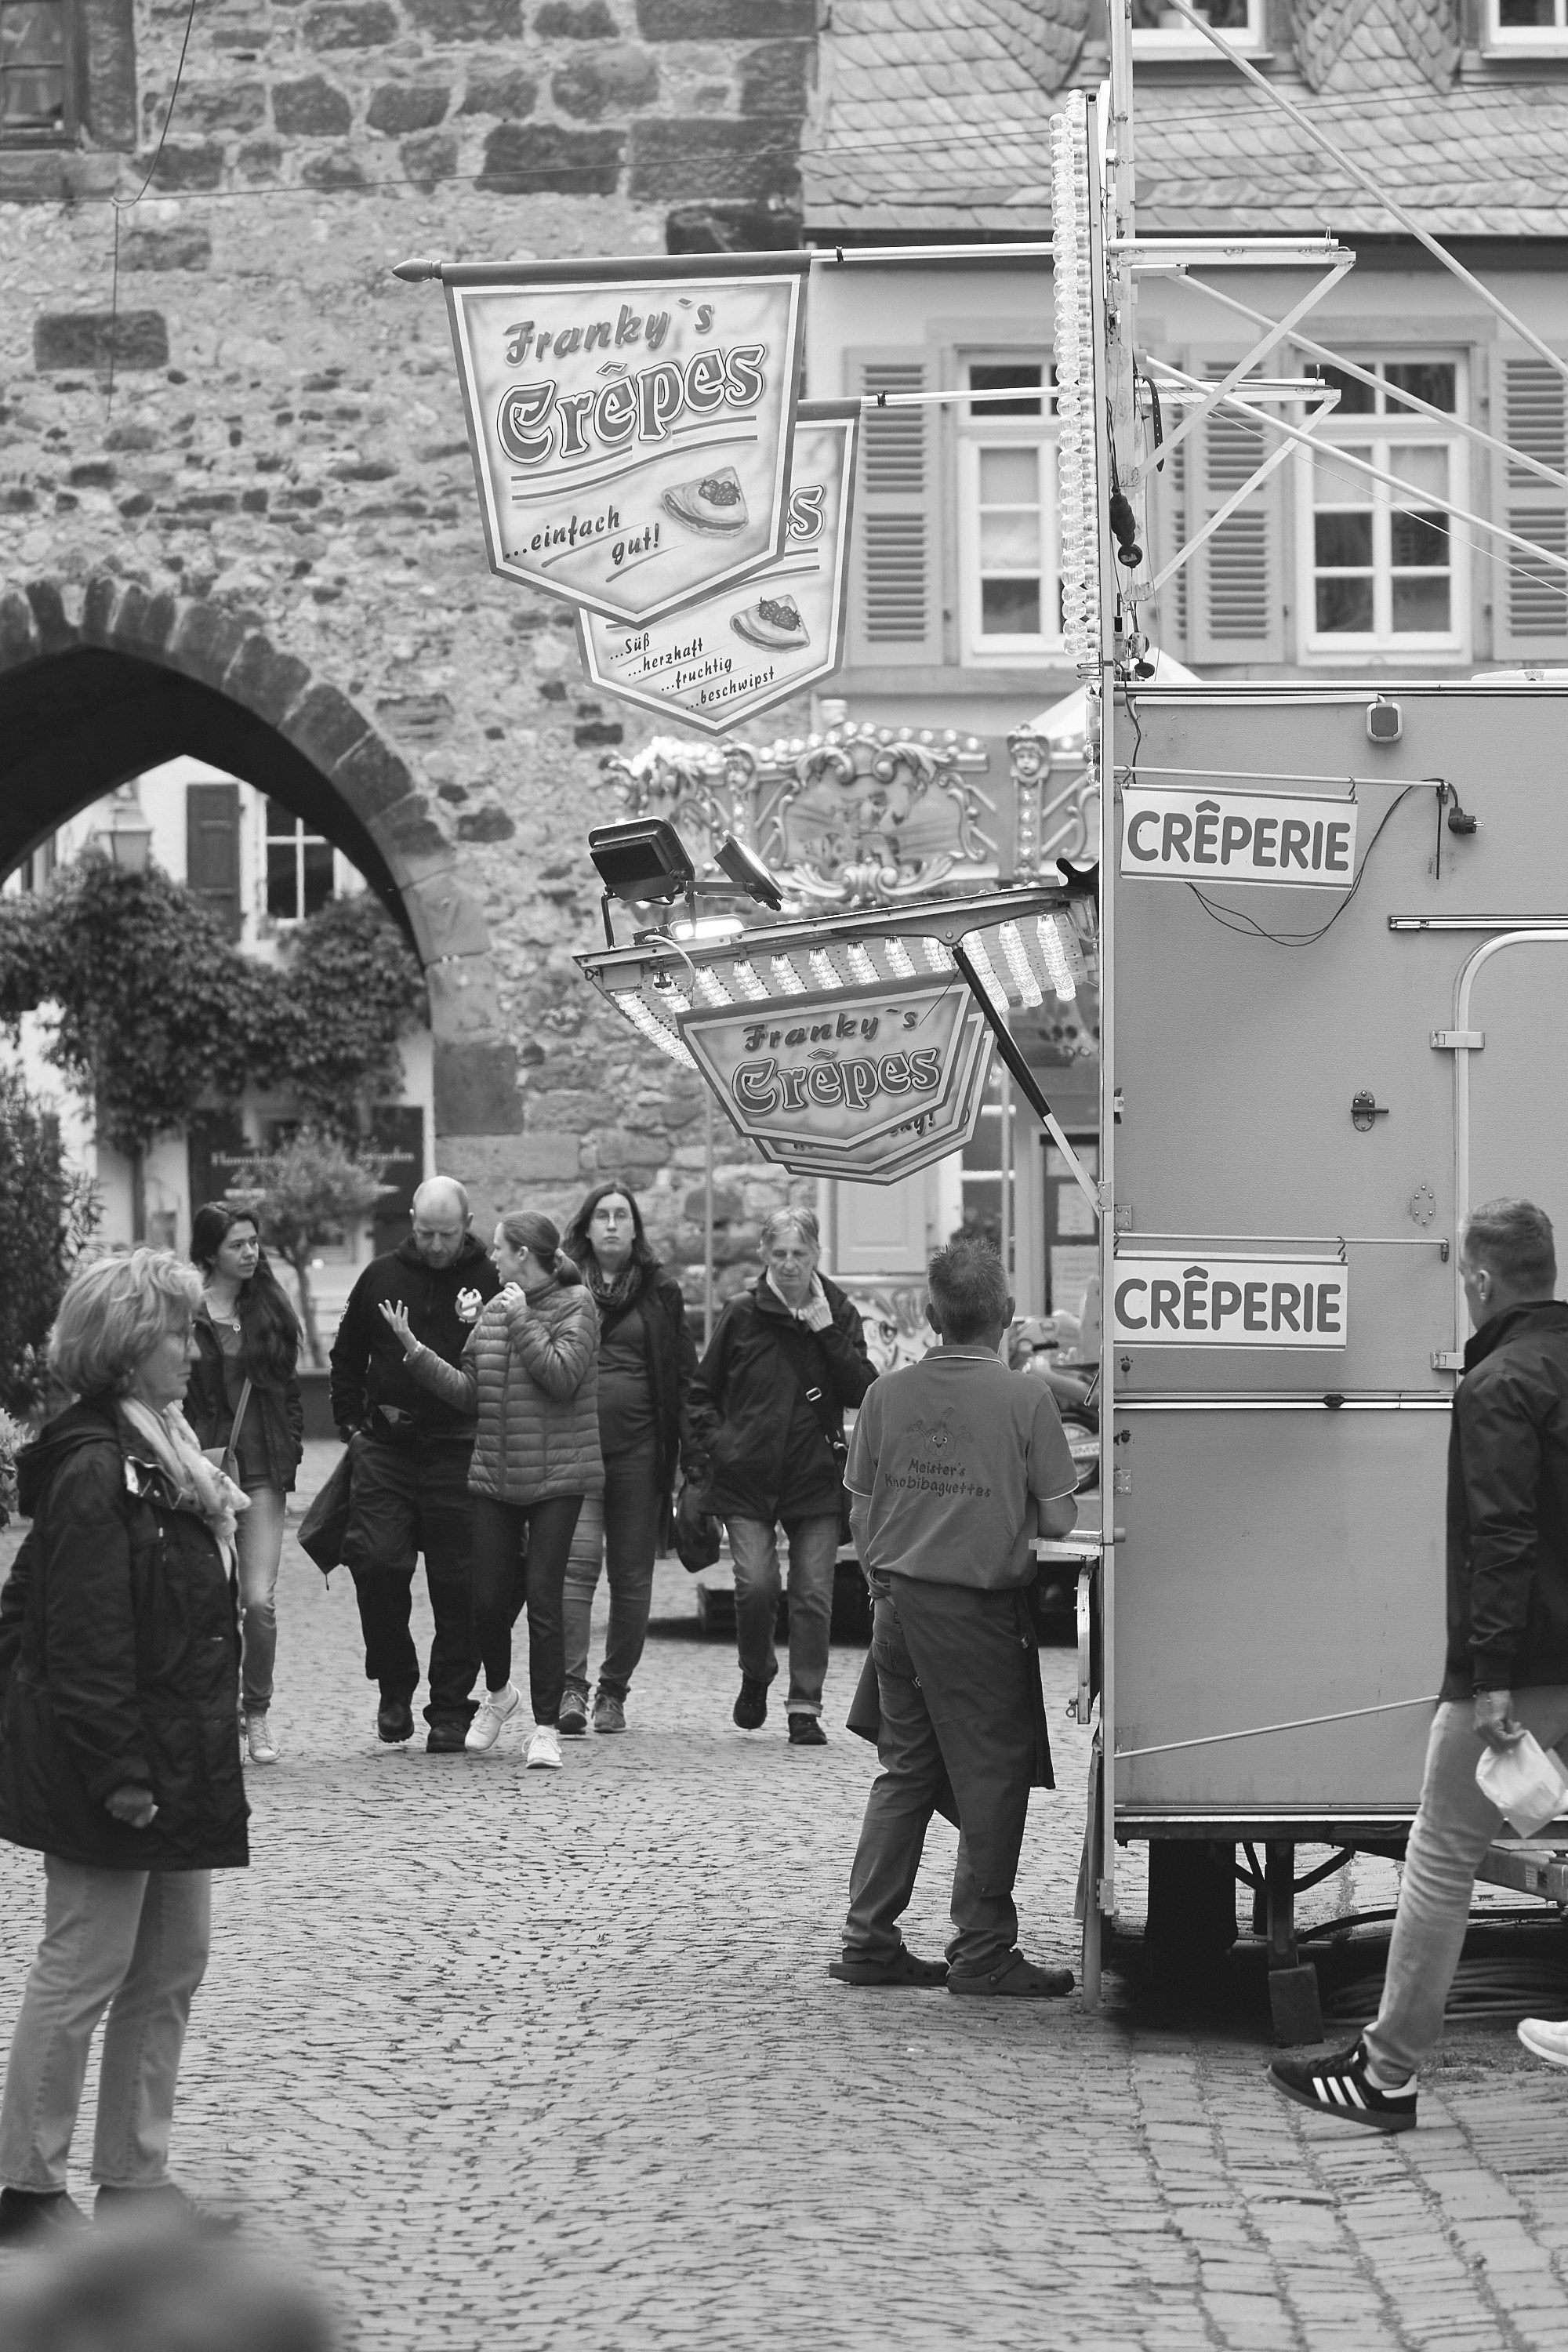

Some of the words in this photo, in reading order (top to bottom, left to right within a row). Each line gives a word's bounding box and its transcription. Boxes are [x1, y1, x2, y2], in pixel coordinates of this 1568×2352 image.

[497, 344, 765, 464] Crêpes
[612, 523, 660, 564] gut!
[1127, 800, 1351, 871] CRÊPERIE
[732, 1047, 941, 1113] Crêpes
[1114, 1265, 1341, 1333] CRÊPERIE
[884, 1473, 991, 1497] Knobibaguettes
